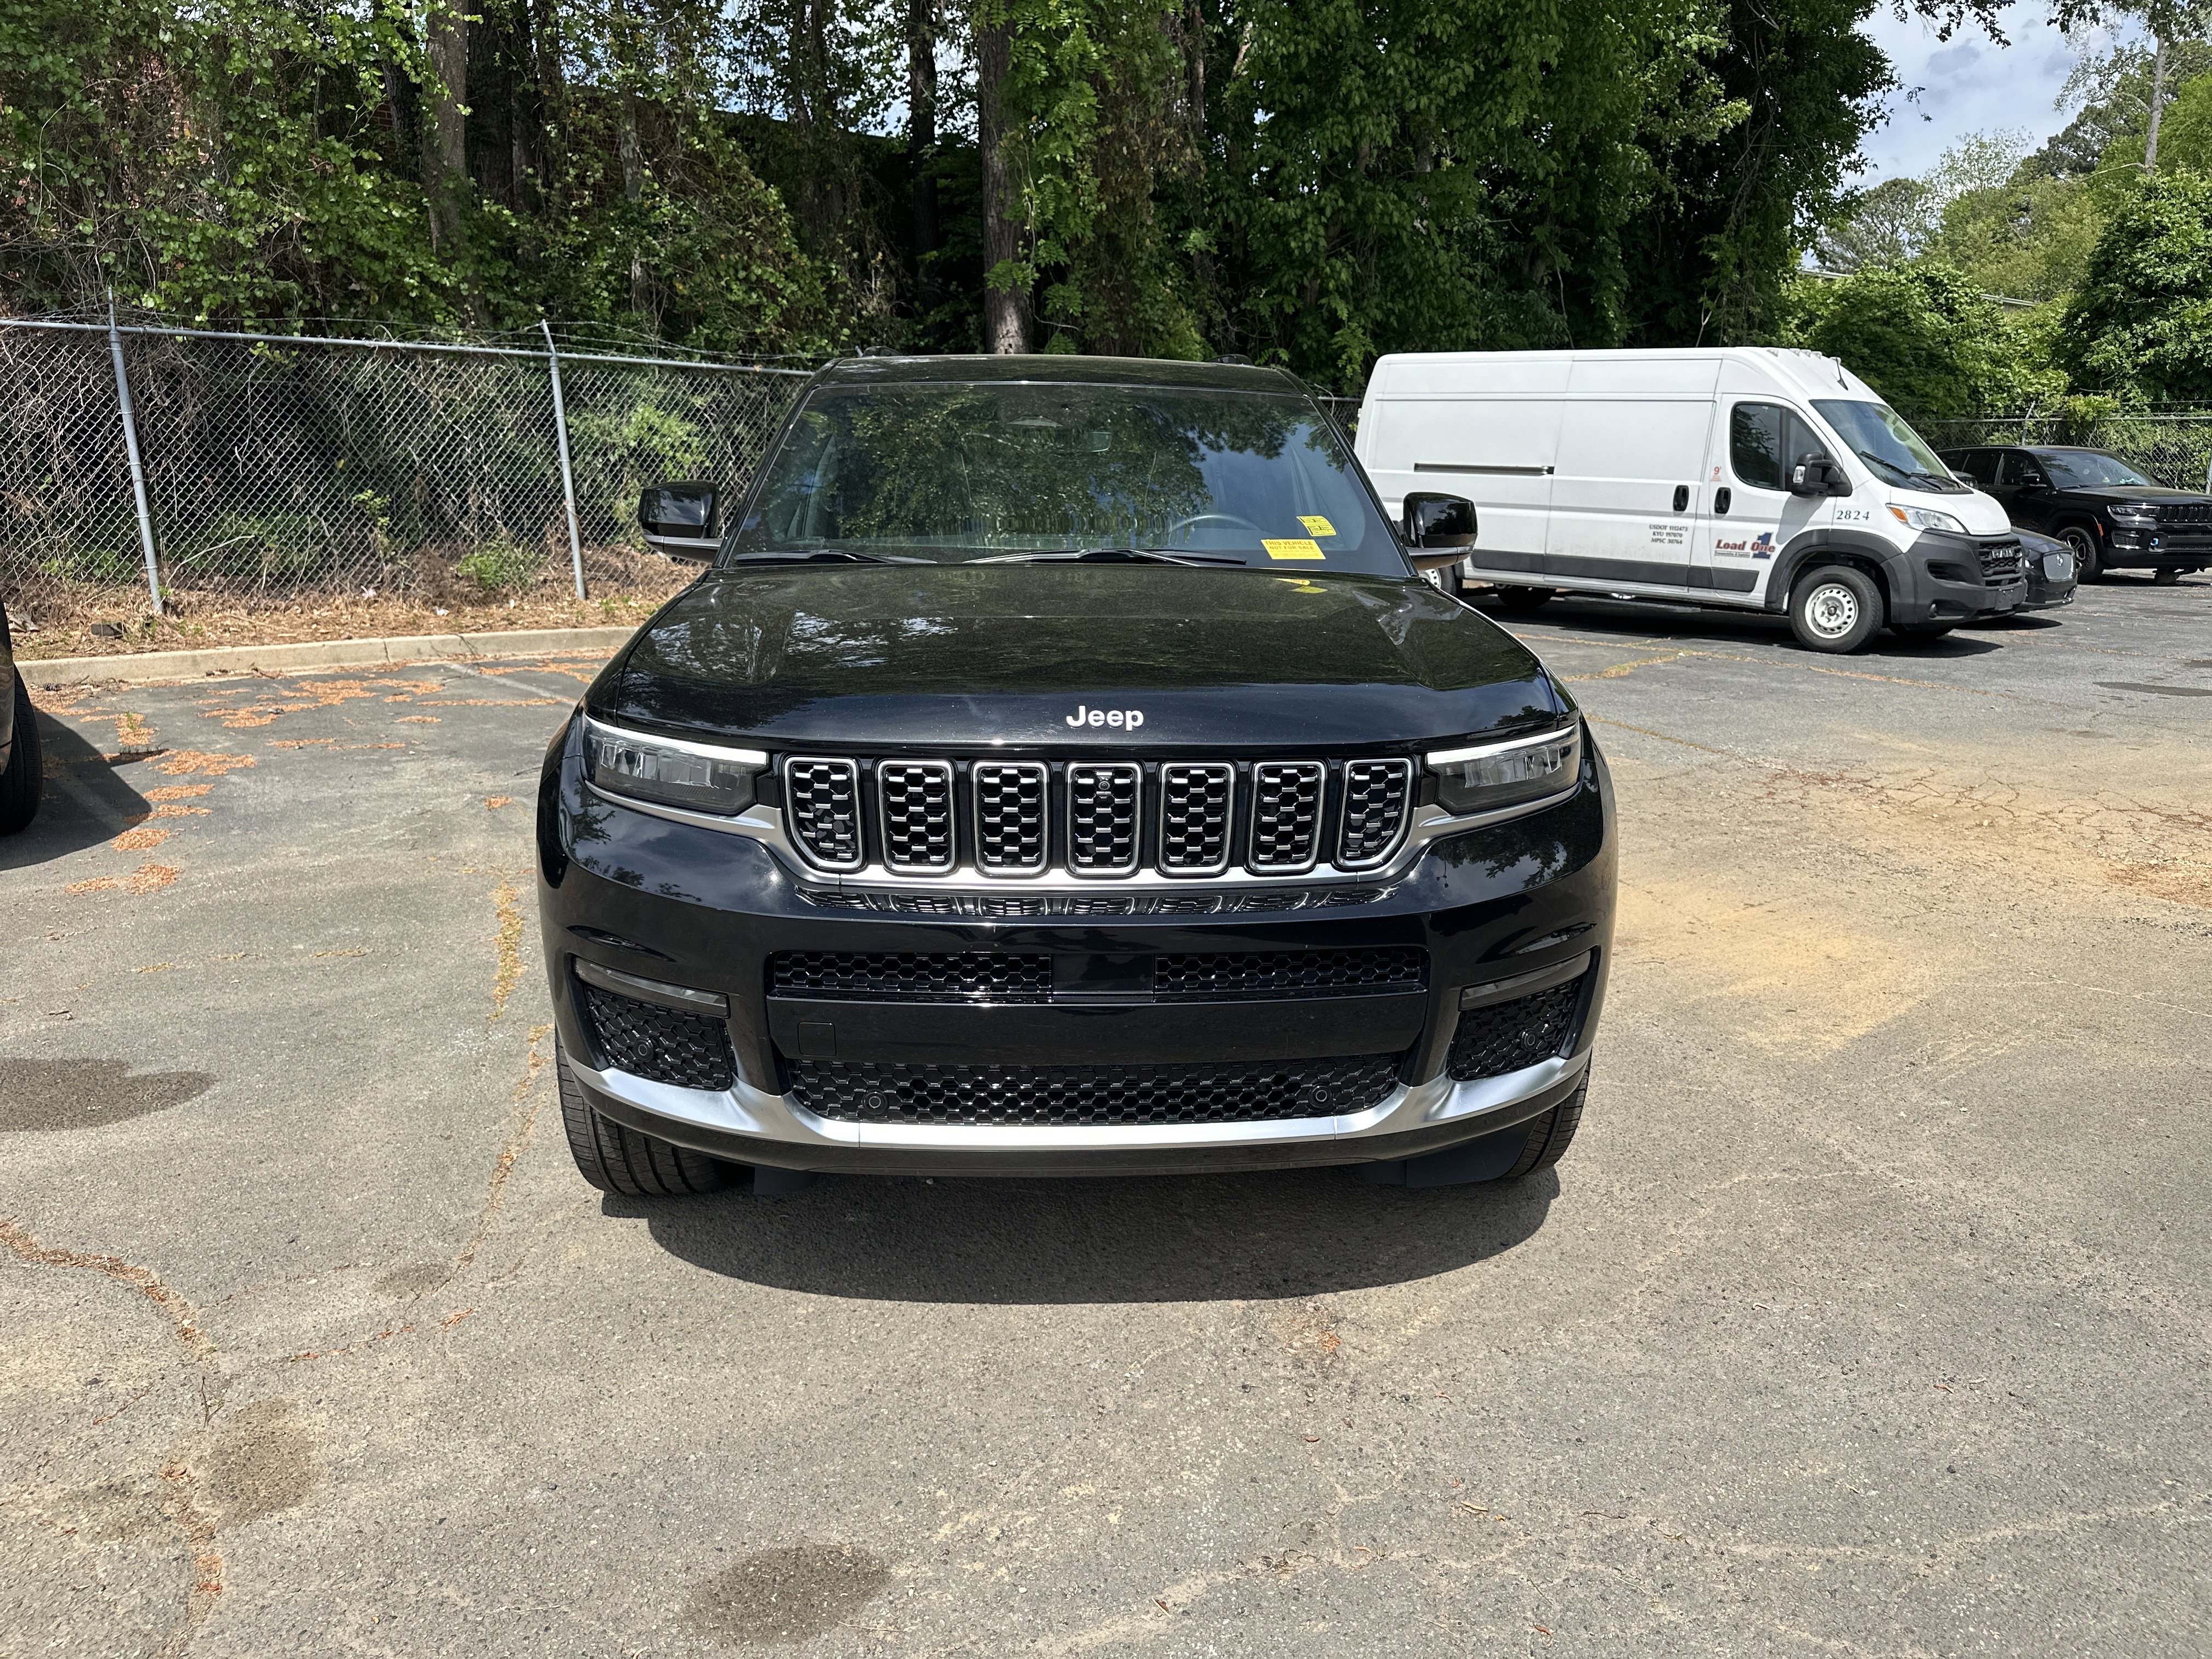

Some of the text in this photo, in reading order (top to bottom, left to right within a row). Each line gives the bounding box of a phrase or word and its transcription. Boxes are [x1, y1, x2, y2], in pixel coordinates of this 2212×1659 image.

[1836, 510, 1870, 521] 2824
[1715, 539, 1776, 552] Load One
[1066, 705, 1144, 732] Jeep
